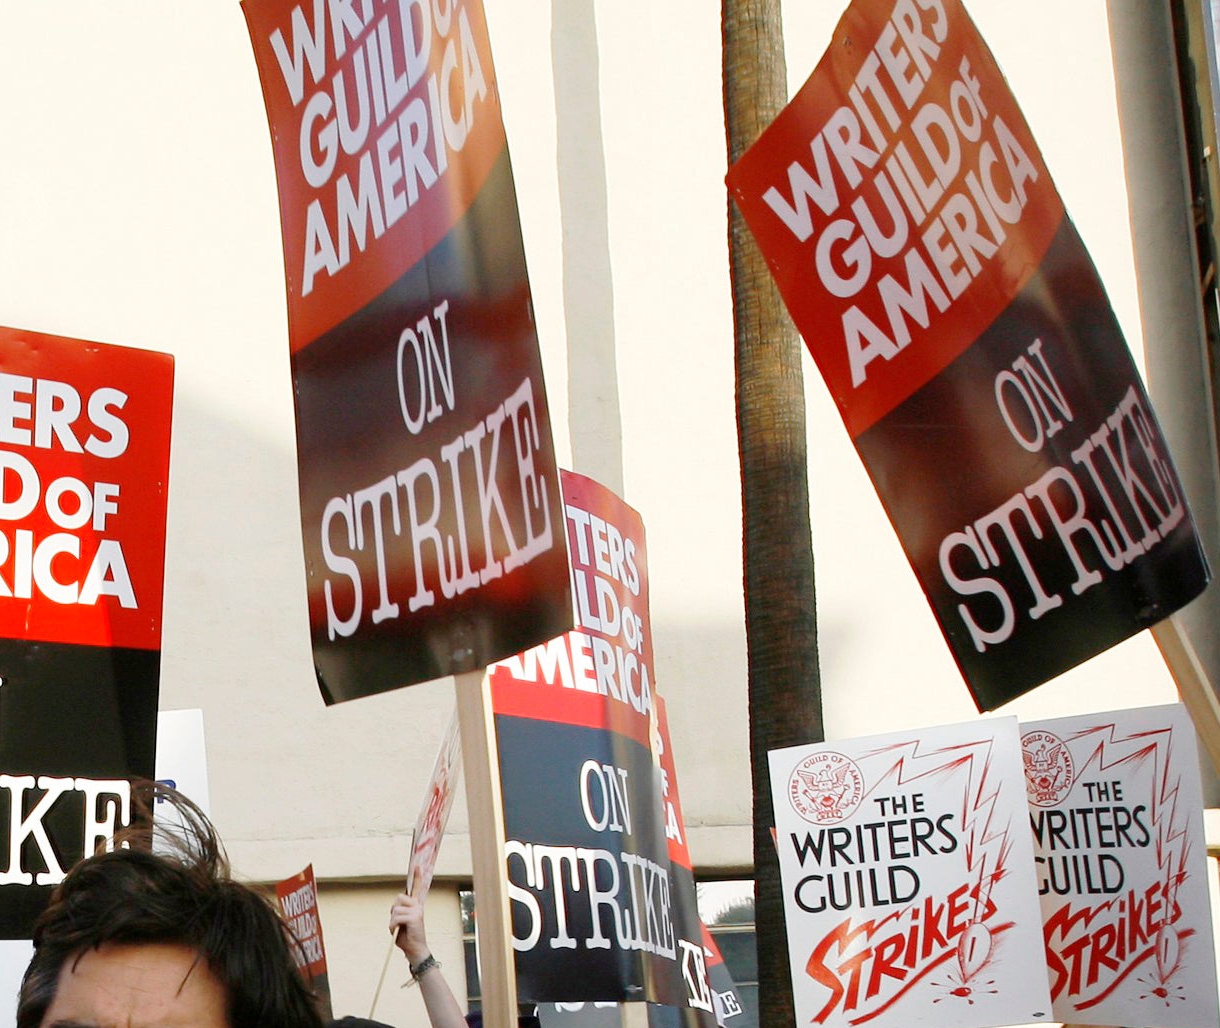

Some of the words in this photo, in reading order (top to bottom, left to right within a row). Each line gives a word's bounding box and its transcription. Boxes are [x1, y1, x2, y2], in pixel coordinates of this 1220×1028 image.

[300, 0, 432, 189] GUILD
[301, 5, 487, 297] AMERICA
[762, 0, 949, 243] WRITERS
[815, 103, 961, 299] GUILD
[950, 55, 988, 142] OF
[840, 115, 1038, 389] AMERICA
[396, 299, 455, 435] ON
[994, 338, 1073, 452] ON
[45, 476, 120, 531] OF
[320, 376, 553, 641] STRIKE
[939, 385, 1184, 653] STRIKE
[621, 607, 643, 654] OF
[580, 759, 632, 835] ON
[790, 813, 958, 869] WRITERS
[874, 793, 925, 817] THE
[1083, 781, 1123, 801] THE
[504, 840, 677, 960] STRIKE
[794, 865, 920, 913] GUILD
